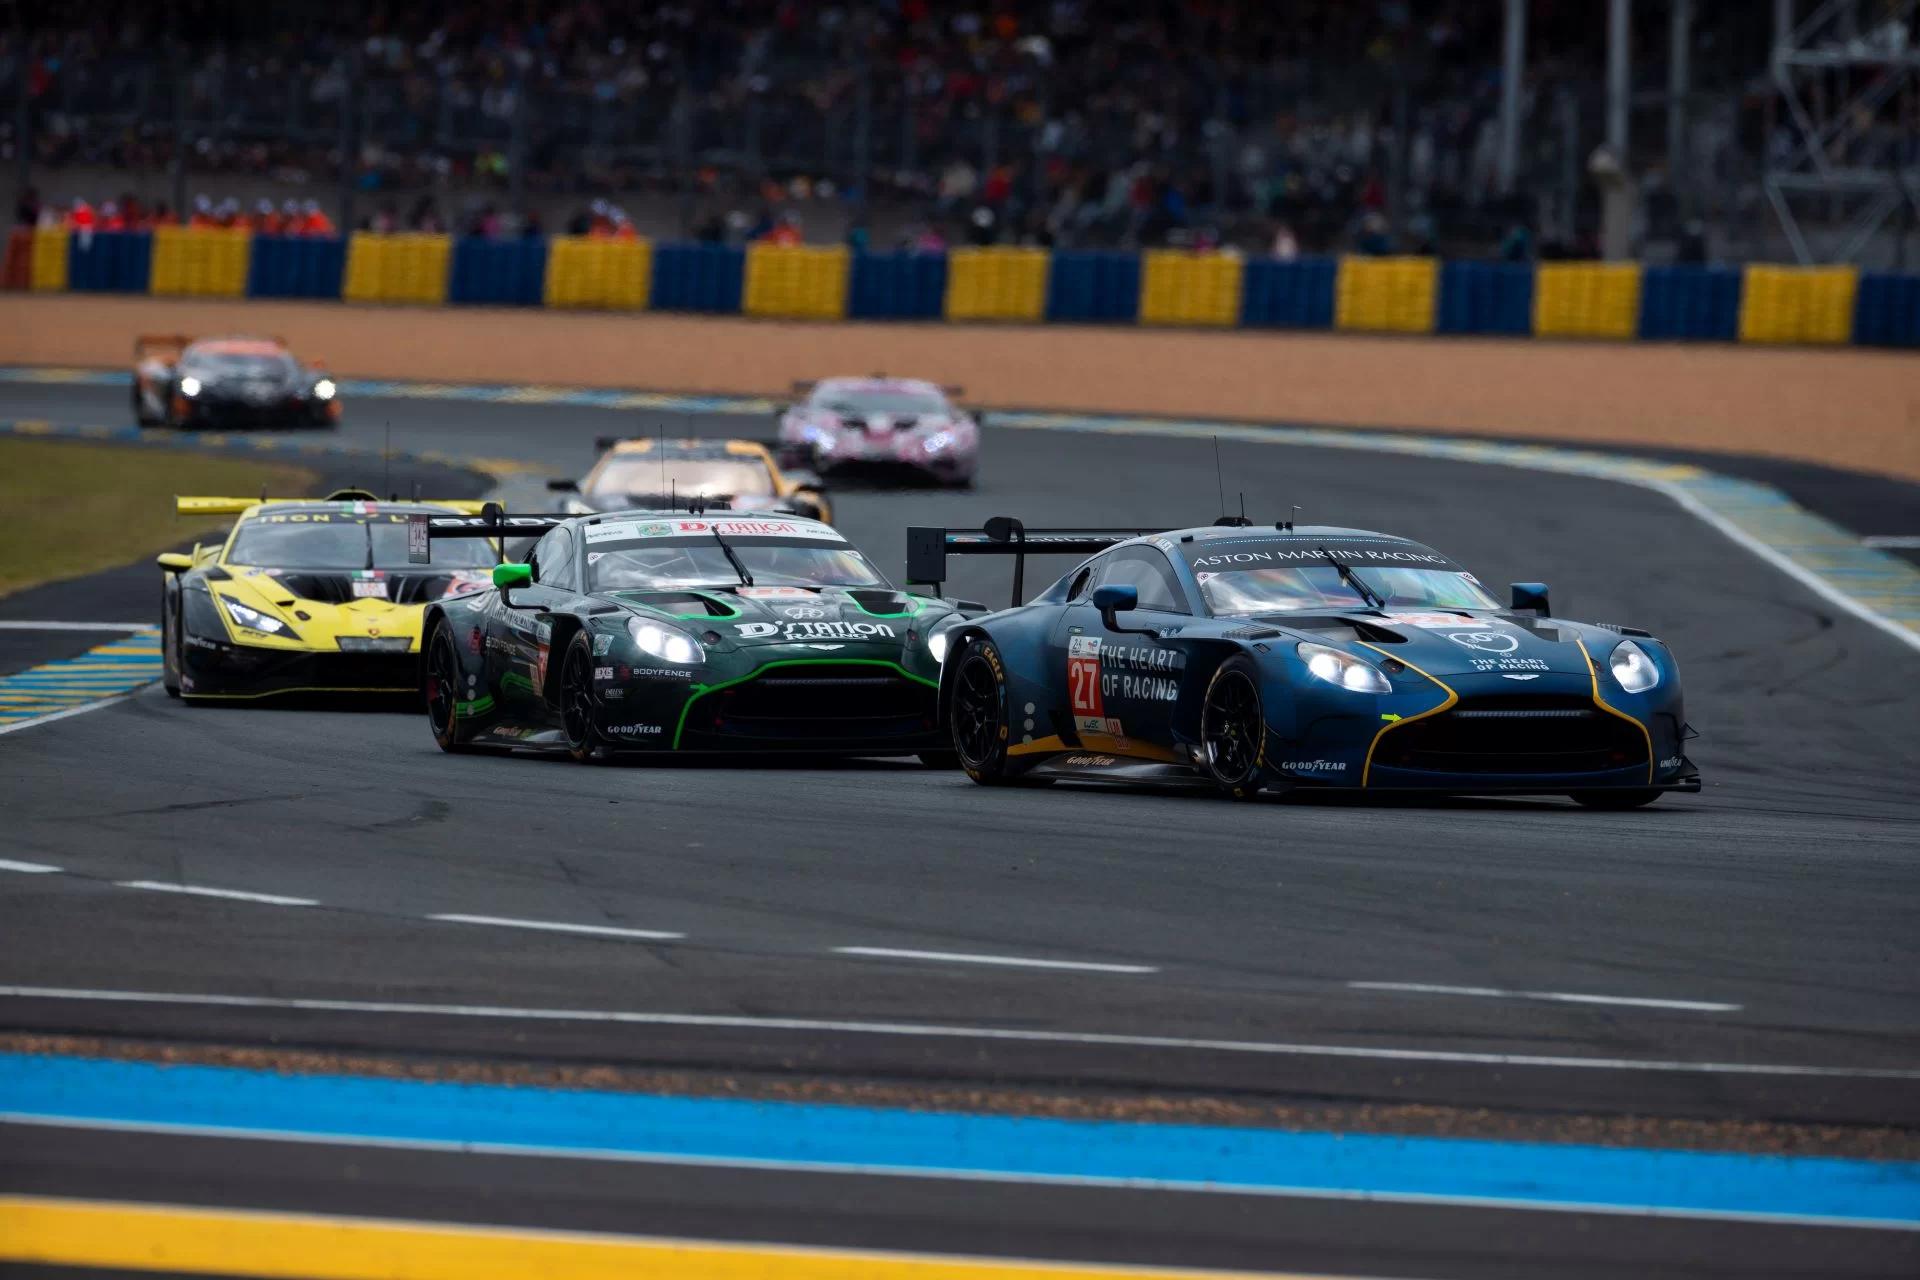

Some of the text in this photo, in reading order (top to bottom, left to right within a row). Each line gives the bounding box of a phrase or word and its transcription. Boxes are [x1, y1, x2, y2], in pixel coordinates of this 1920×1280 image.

[260, 514, 330, 523] IRON
[1193, 550, 1447, 567] ASTON MARTIN RACING
[734, 621, 895, 639] D'STATION
[786, 633, 869, 641] RACING
[983, 646, 1004, 683] EAGLE
[1101, 645, 1177, 672] THE HEART
[633, 668, 692, 678] BODYFENCE
[1071, 661, 1097, 710] 27
[1102, 674, 1178, 701] OF RACING
[607, 723, 662, 736] GOODYEAR
[1084, 720, 1098, 729] WEC
[1281, 759, 1347, 772] GOODYEAR
